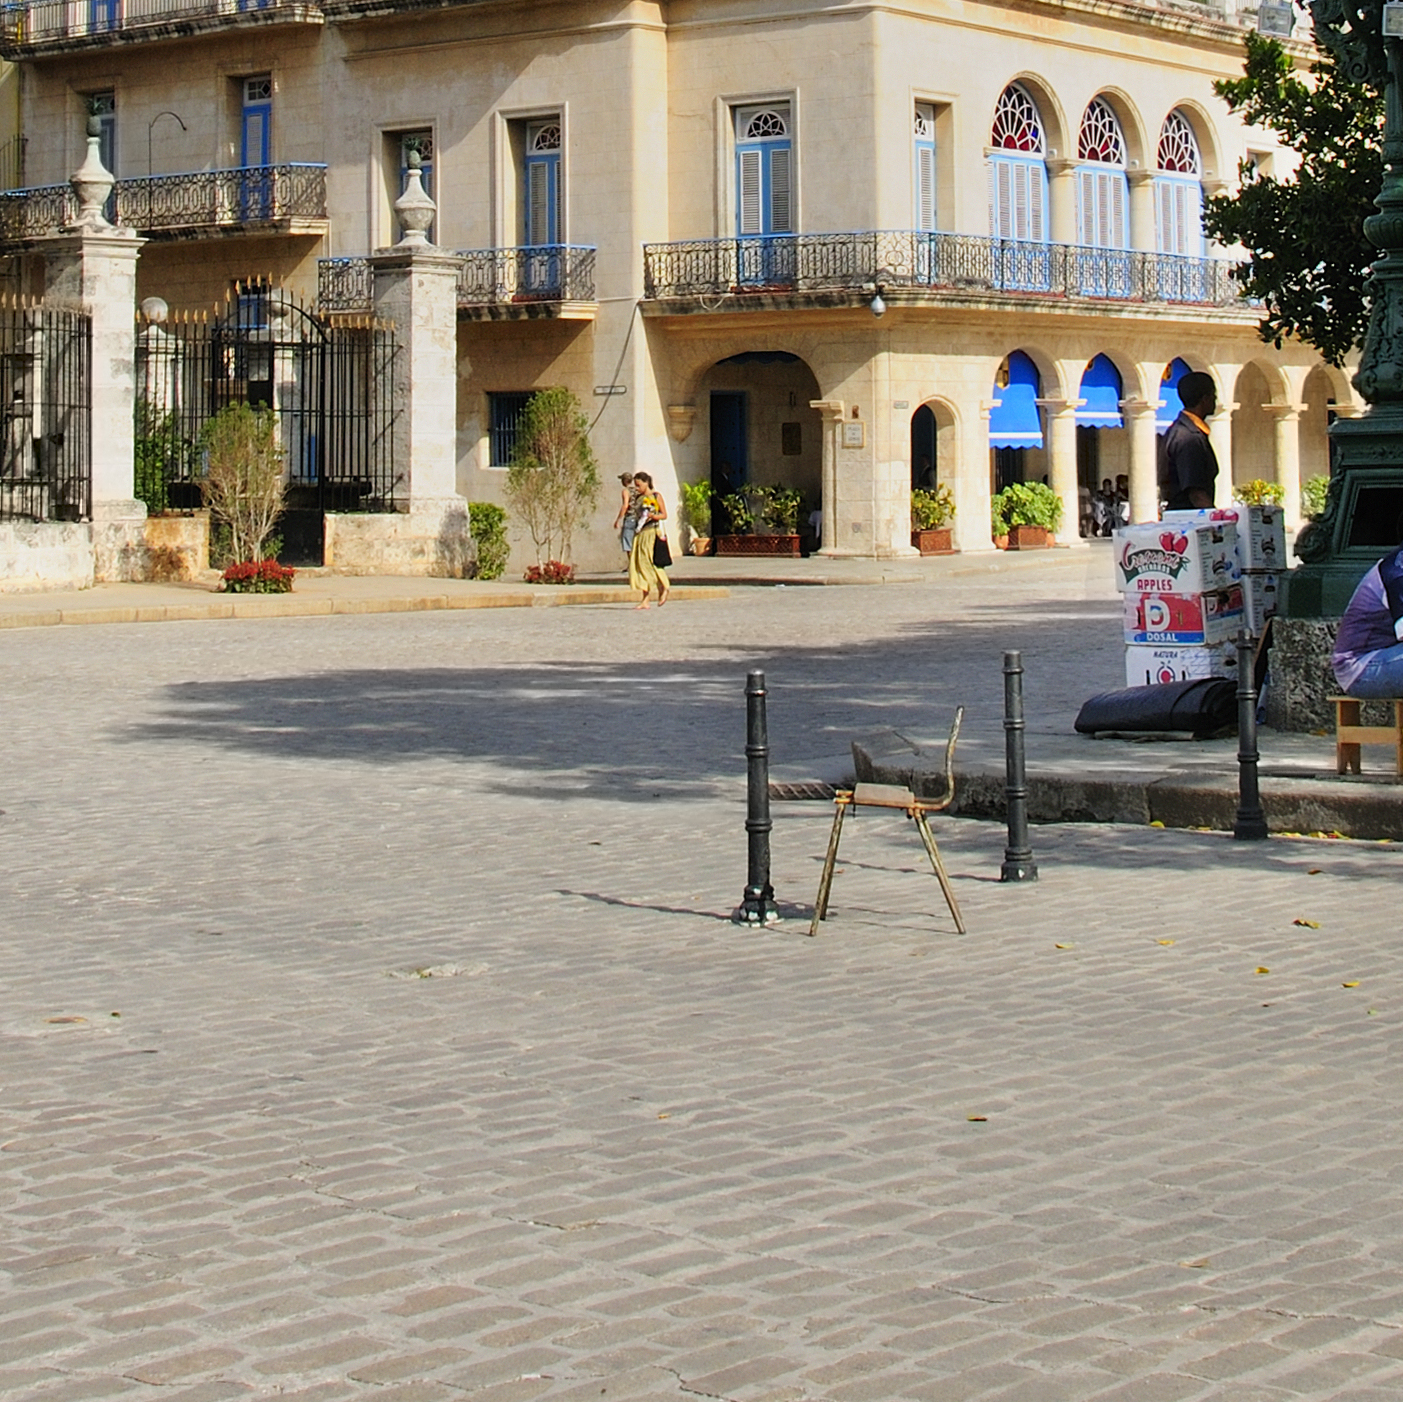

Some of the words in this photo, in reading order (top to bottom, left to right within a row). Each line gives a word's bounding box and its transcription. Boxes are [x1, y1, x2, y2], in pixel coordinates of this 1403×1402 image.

[1137, 579, 1173, 591] APPLES
[1146, 632, 1179, 642] DOSAL
[1153, 650, 1178, 659] NATURA
